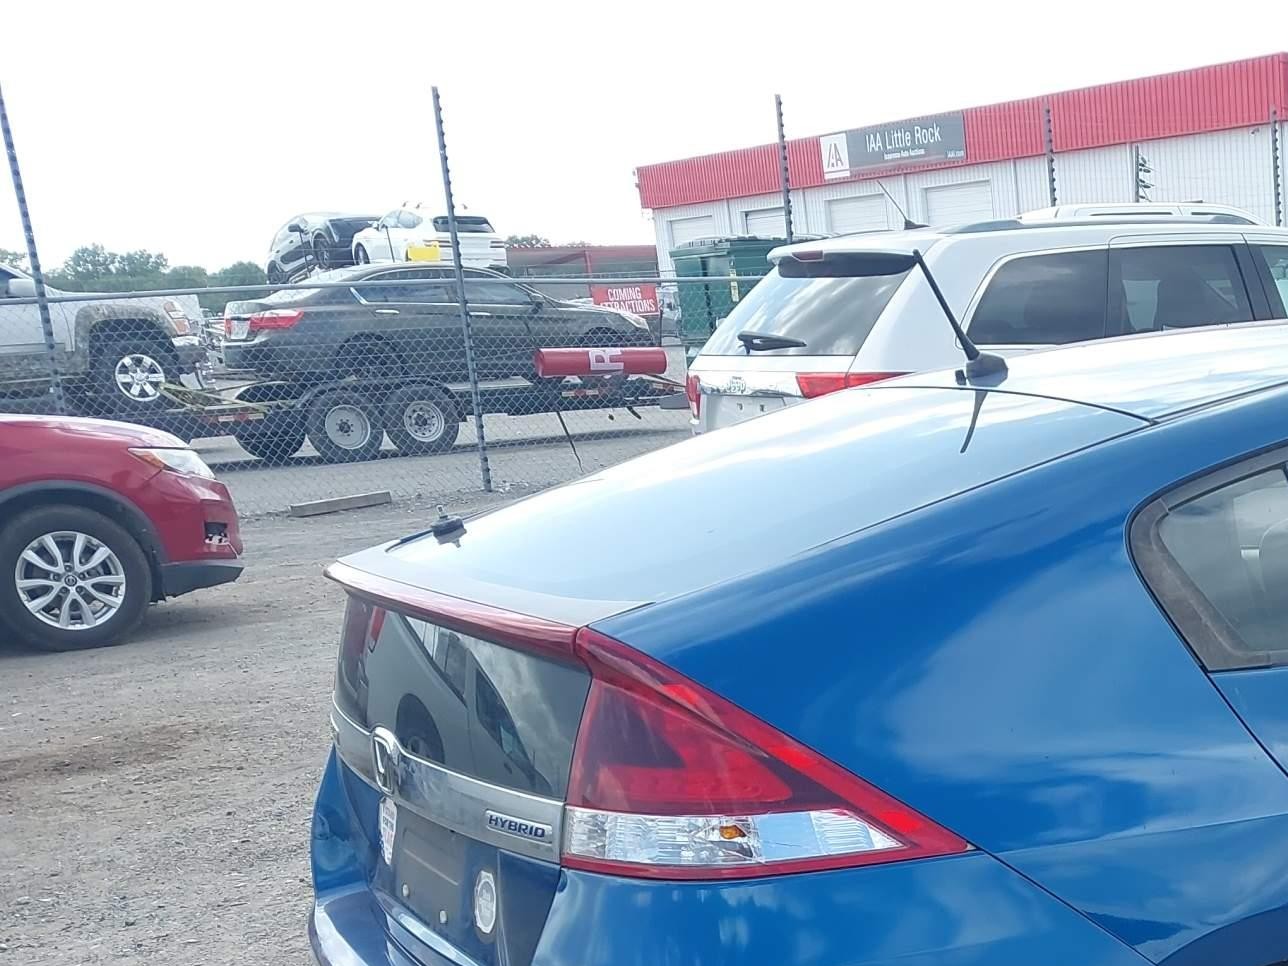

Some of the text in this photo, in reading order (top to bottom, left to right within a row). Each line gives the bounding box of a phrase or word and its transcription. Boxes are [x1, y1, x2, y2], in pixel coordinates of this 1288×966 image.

[865, 121, 942, 153] IAA Little Rock
[607, 286, 642, 301] COMING
[600, 299, 656, 314] TRACTIONS
[488, 814, 546, 839] HYBRID
